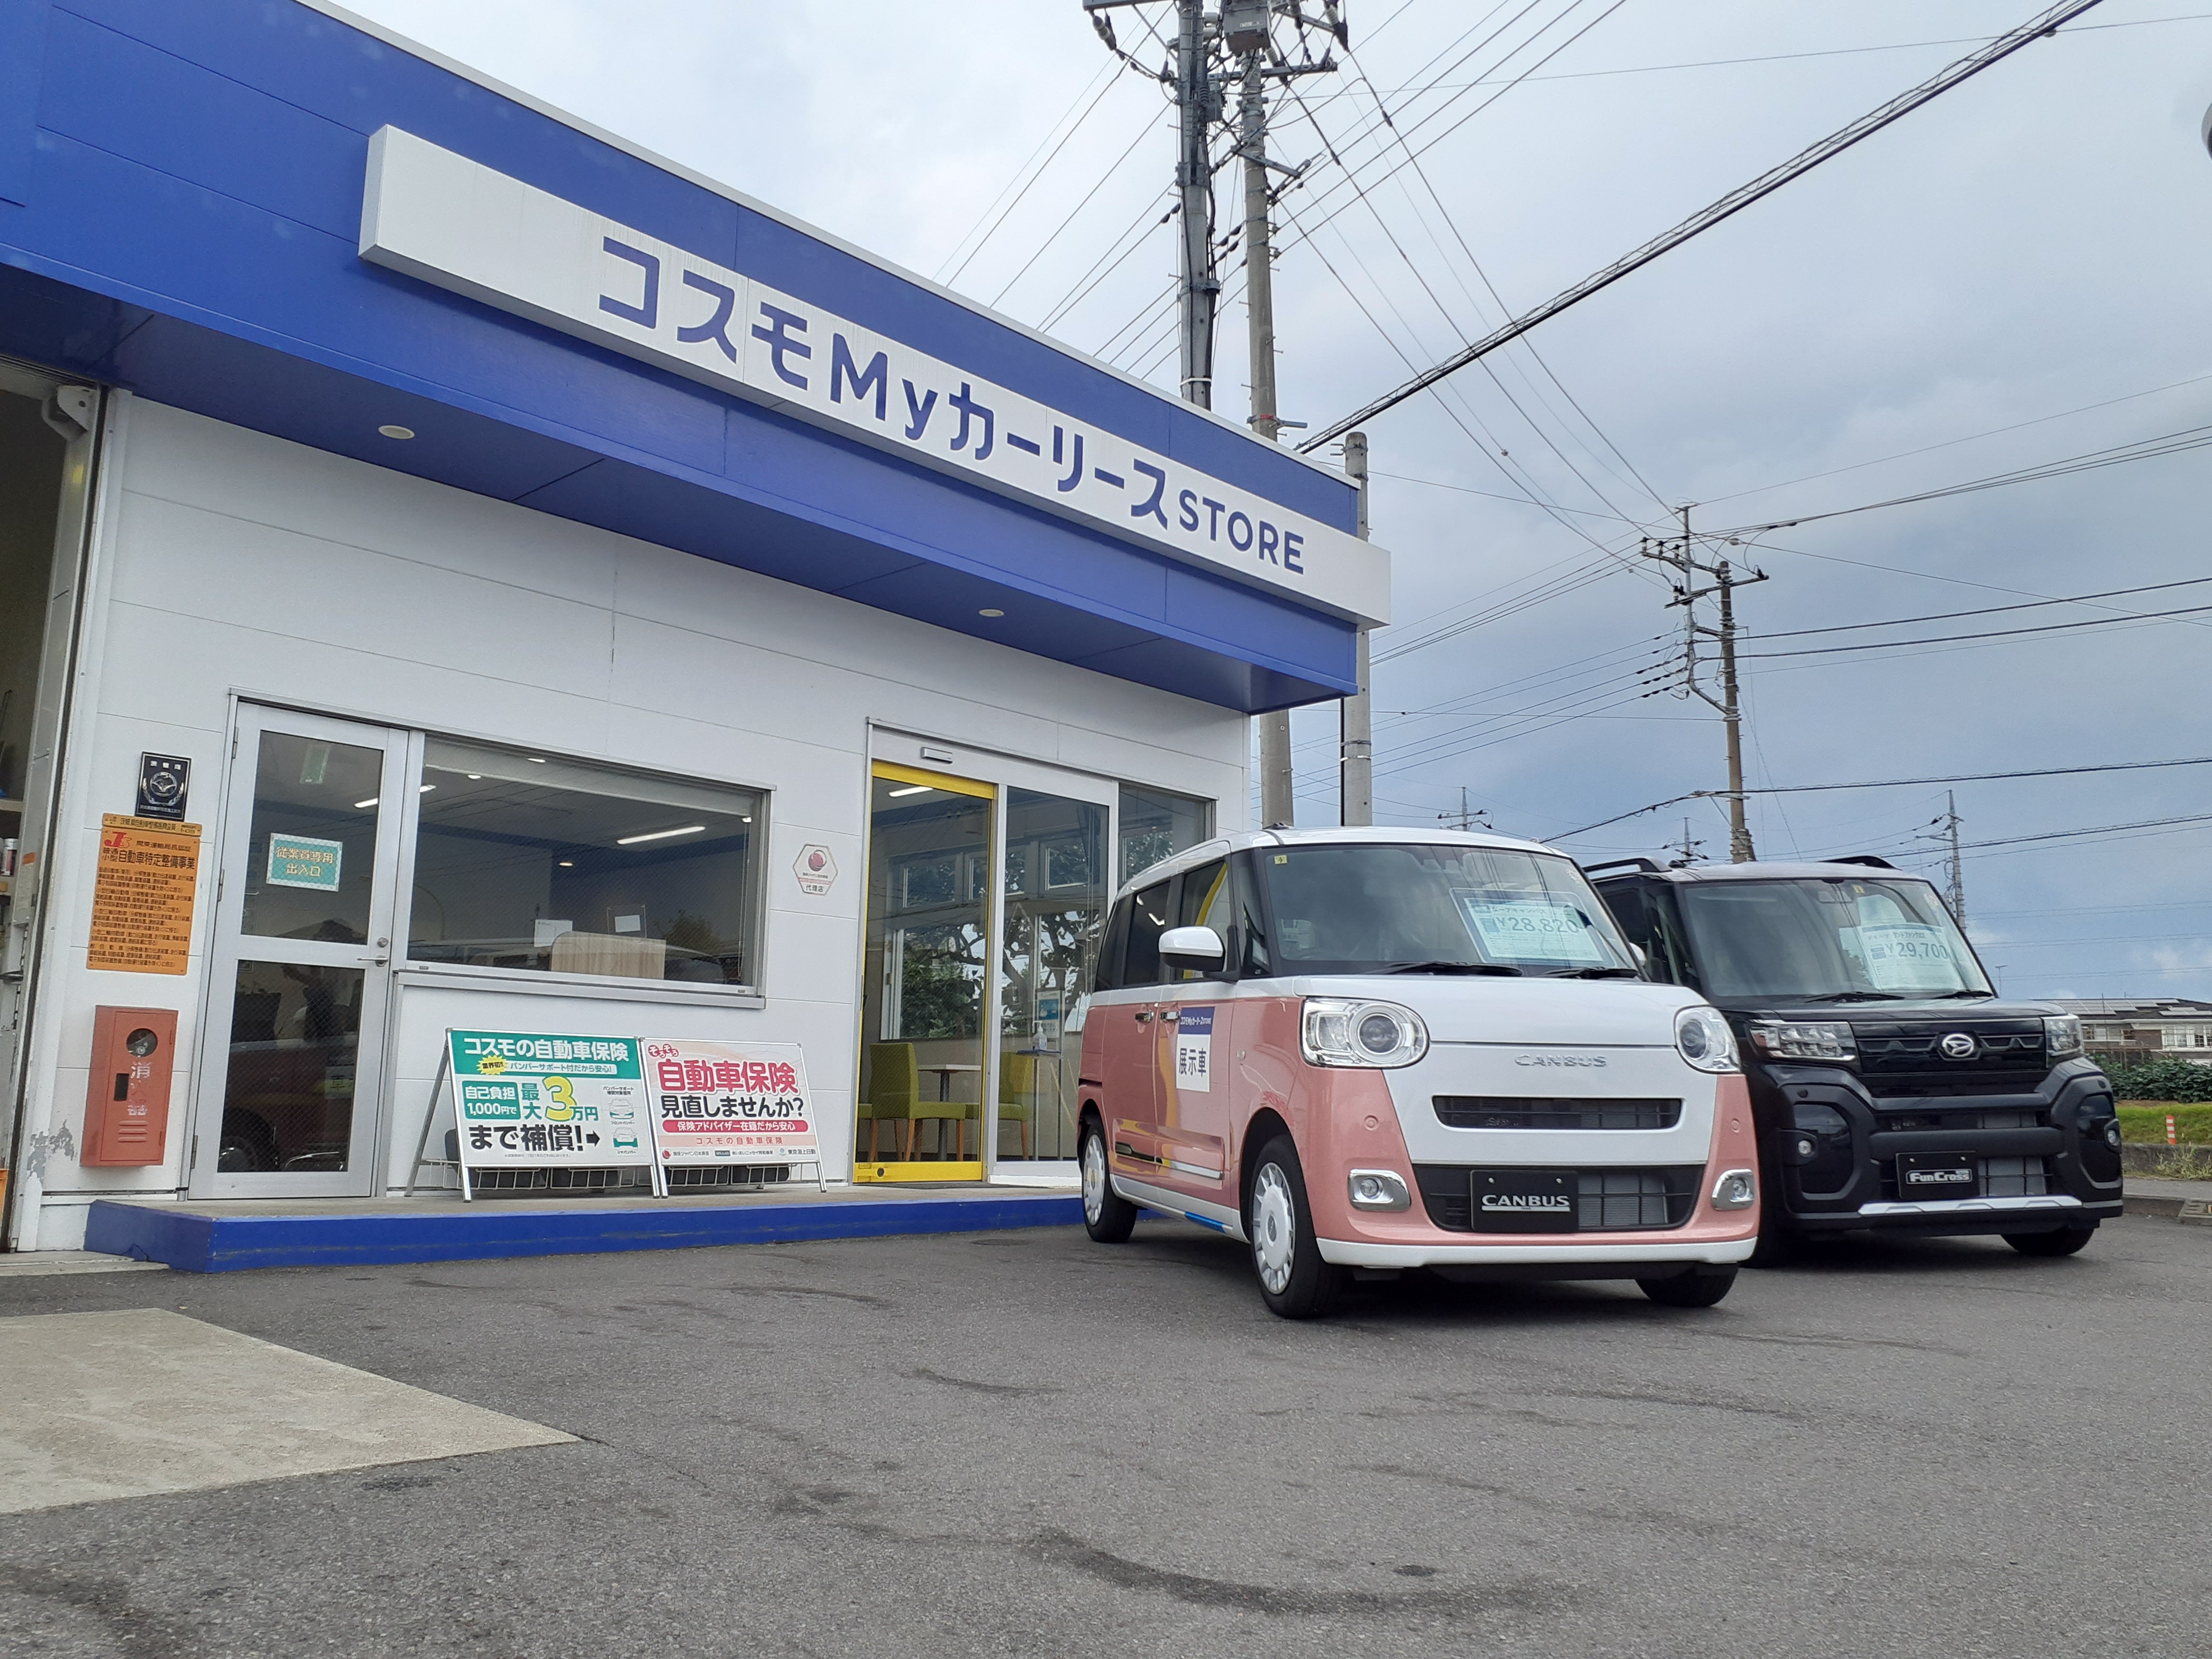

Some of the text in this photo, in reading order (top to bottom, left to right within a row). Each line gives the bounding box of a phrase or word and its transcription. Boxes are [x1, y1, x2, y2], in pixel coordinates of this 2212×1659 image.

[276, 846, 333, 864] 従業員専用
[287, 863, 321, 877] 出入口
[806, 884, 824, 892] 代理店
[464, 1037, 630, 1062] コスモの自動車保険
[649, 1045, 678, 1058] そろそろ
[1179, 1048, 1207, 1077] 展示車
[1514, 1054, 1607, 1067] CANBUS
[657, 1058, 799, 1094] 自動車保険
[465, 1086, 516, 1100] 自己負担
[467, 1102, 517, 1116] 1,000円で
[661, 1095, 804, 1118] 見直しませんか?
[677, 1121, 796, 1131] 保険アドバイザー在籍だから安心
[468, 1124, 584, 1152] まで補償!
[697, 1137, 783, 1145] コスモの自動車保険
[1482, 1194, 1570, 1206] CANBUS
